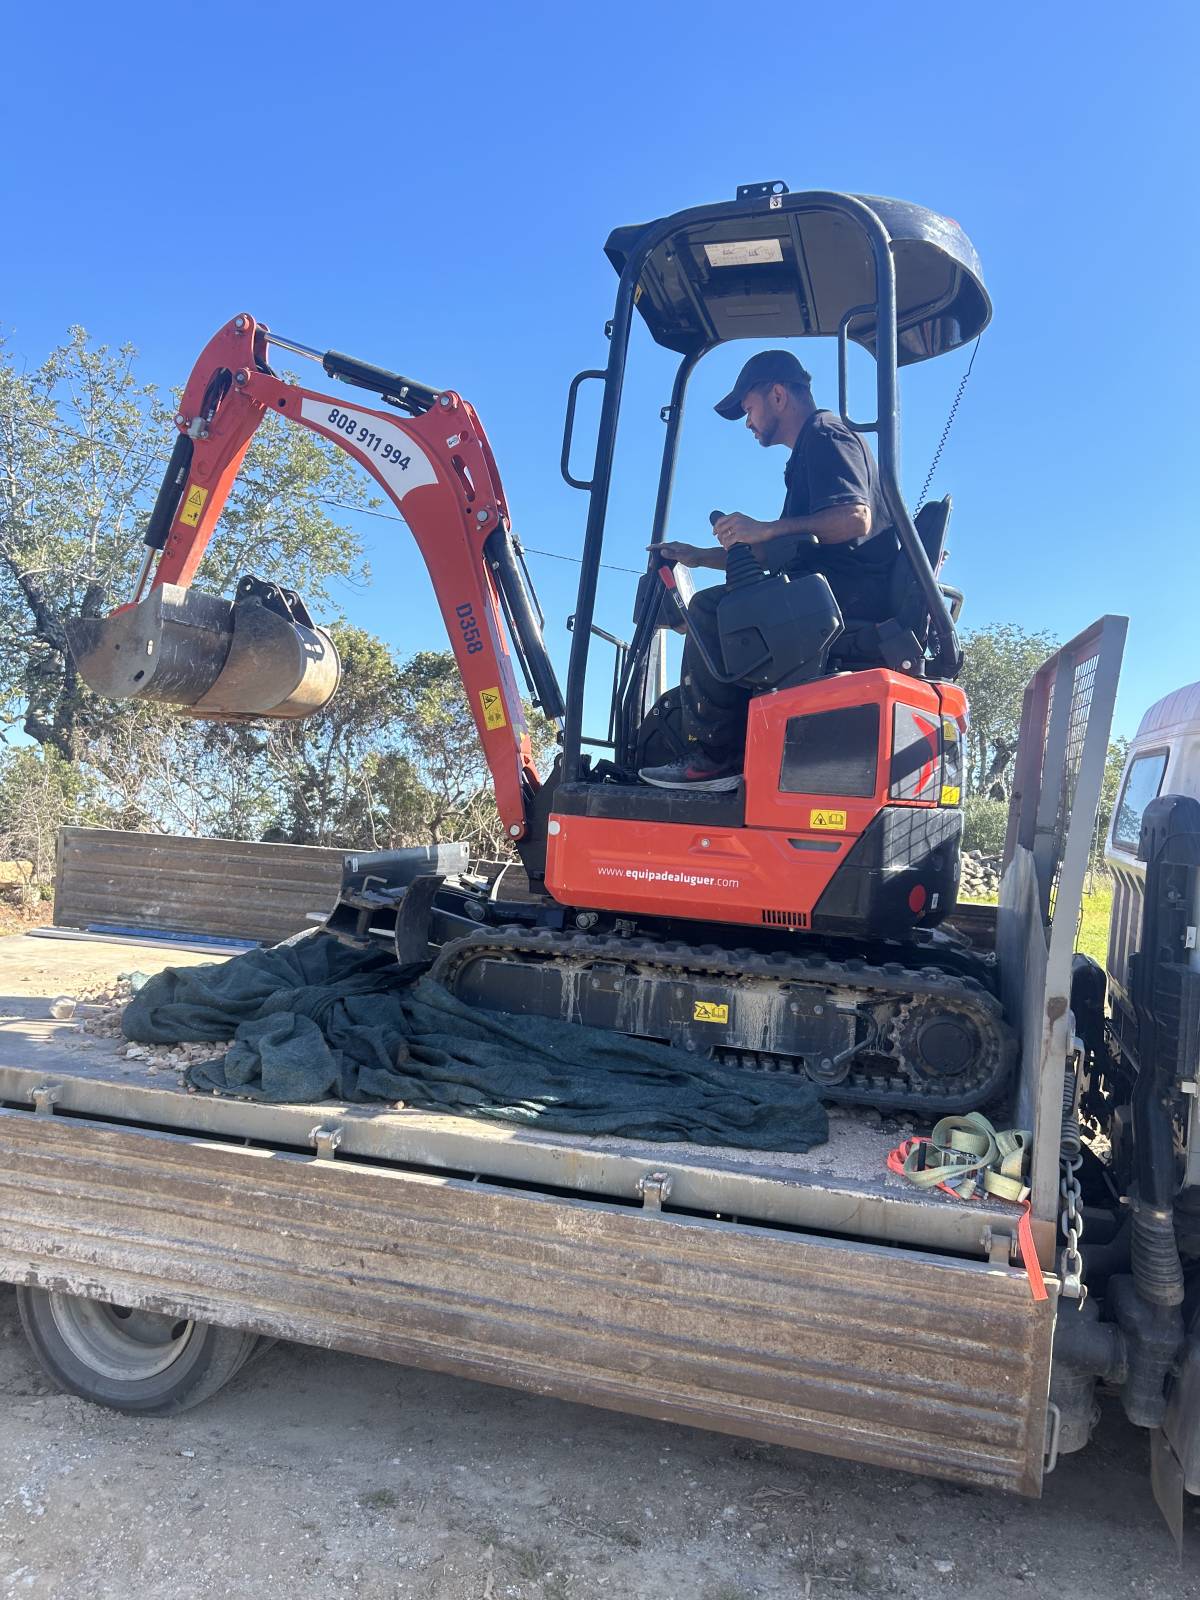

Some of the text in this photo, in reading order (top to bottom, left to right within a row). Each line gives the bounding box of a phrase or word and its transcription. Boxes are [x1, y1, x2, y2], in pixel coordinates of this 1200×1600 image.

[328, 408, 411, 471] 808 911 994
[456, 602, 484, 655] D358
[597, 866, 739, 888] www.equipadealuguer.com
